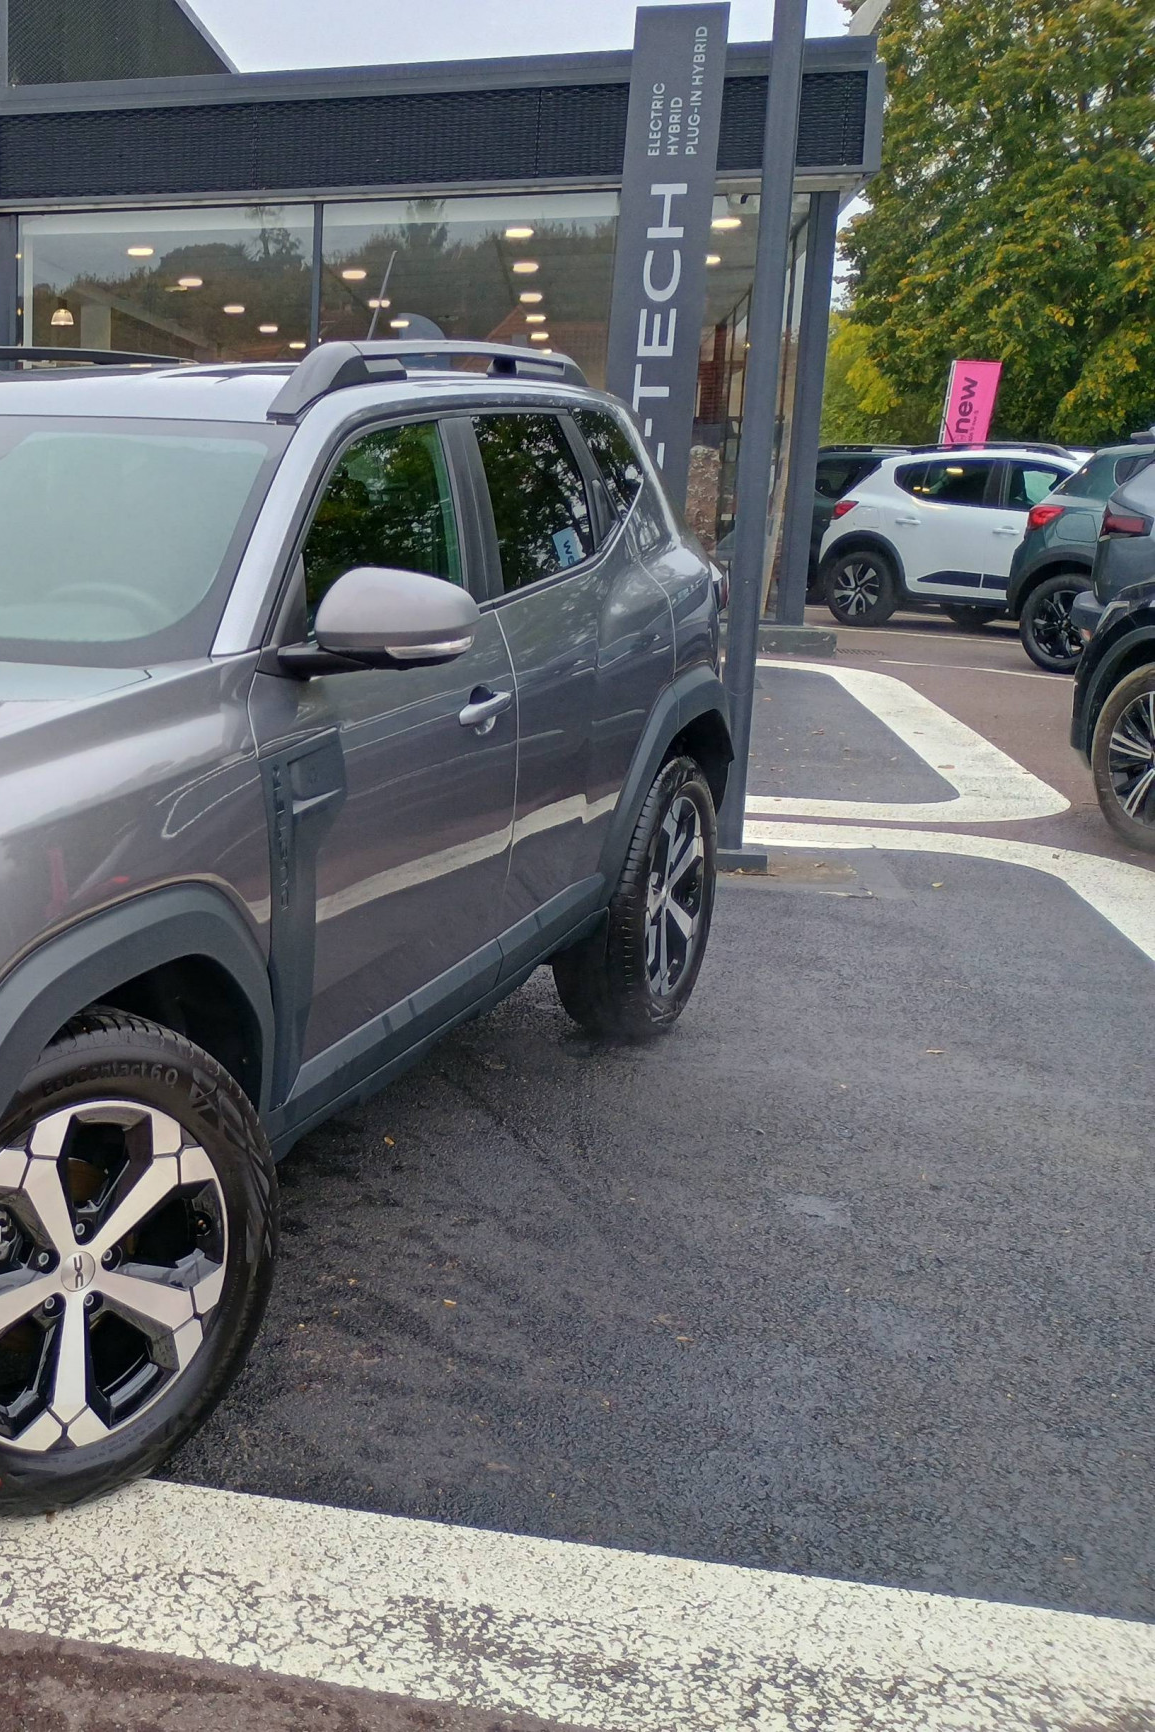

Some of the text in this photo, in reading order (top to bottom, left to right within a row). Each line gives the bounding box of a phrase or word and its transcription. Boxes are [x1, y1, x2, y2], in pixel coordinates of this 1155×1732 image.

[647, 82, 665, 156] ELECTRIC
[666, 97, 683, 155] HYBRID
[685, 26, 708, 155] PLUG-IN HYBRID
[633, 183, 688, 470] -TECH
